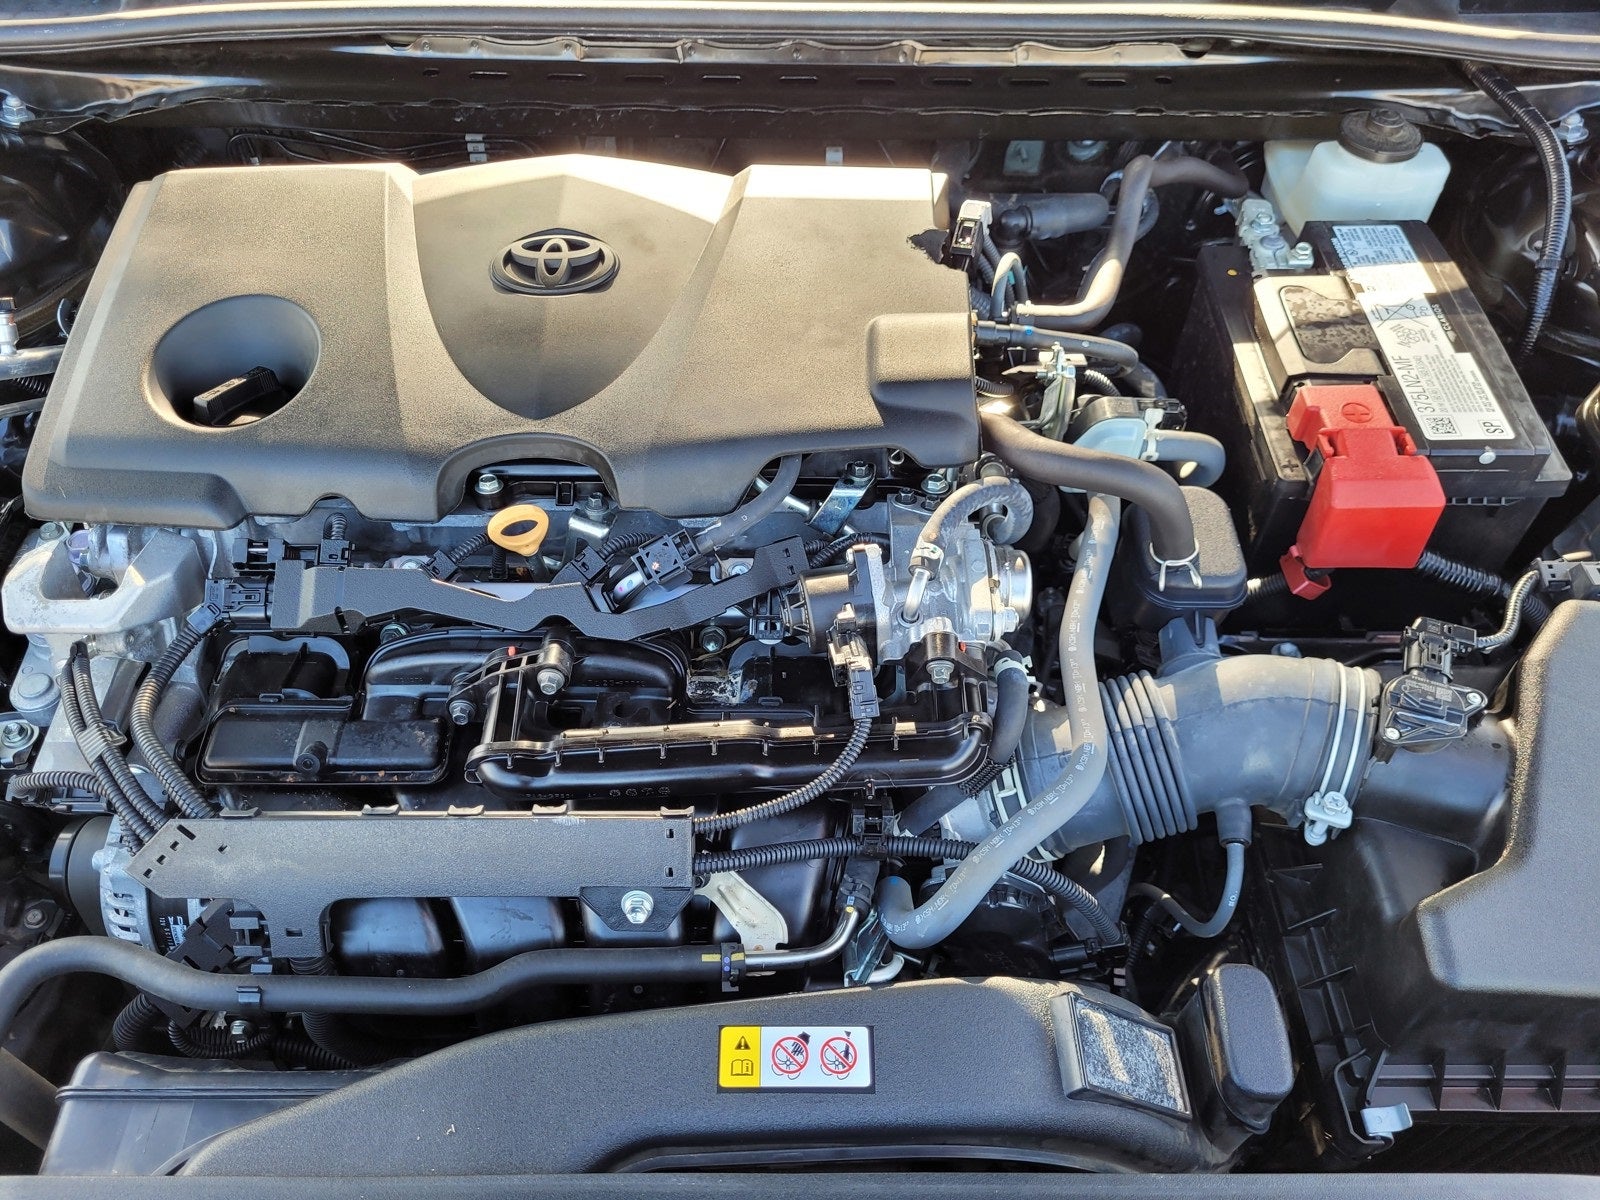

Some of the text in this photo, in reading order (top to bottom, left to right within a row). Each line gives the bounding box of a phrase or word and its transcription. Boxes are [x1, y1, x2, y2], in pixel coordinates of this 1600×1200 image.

[1431, 303, 1451, 331] CLARIOS
[1391, 355, 1435, 413] 375LN2-MF
[1482, 421, 1505, 434] SP
